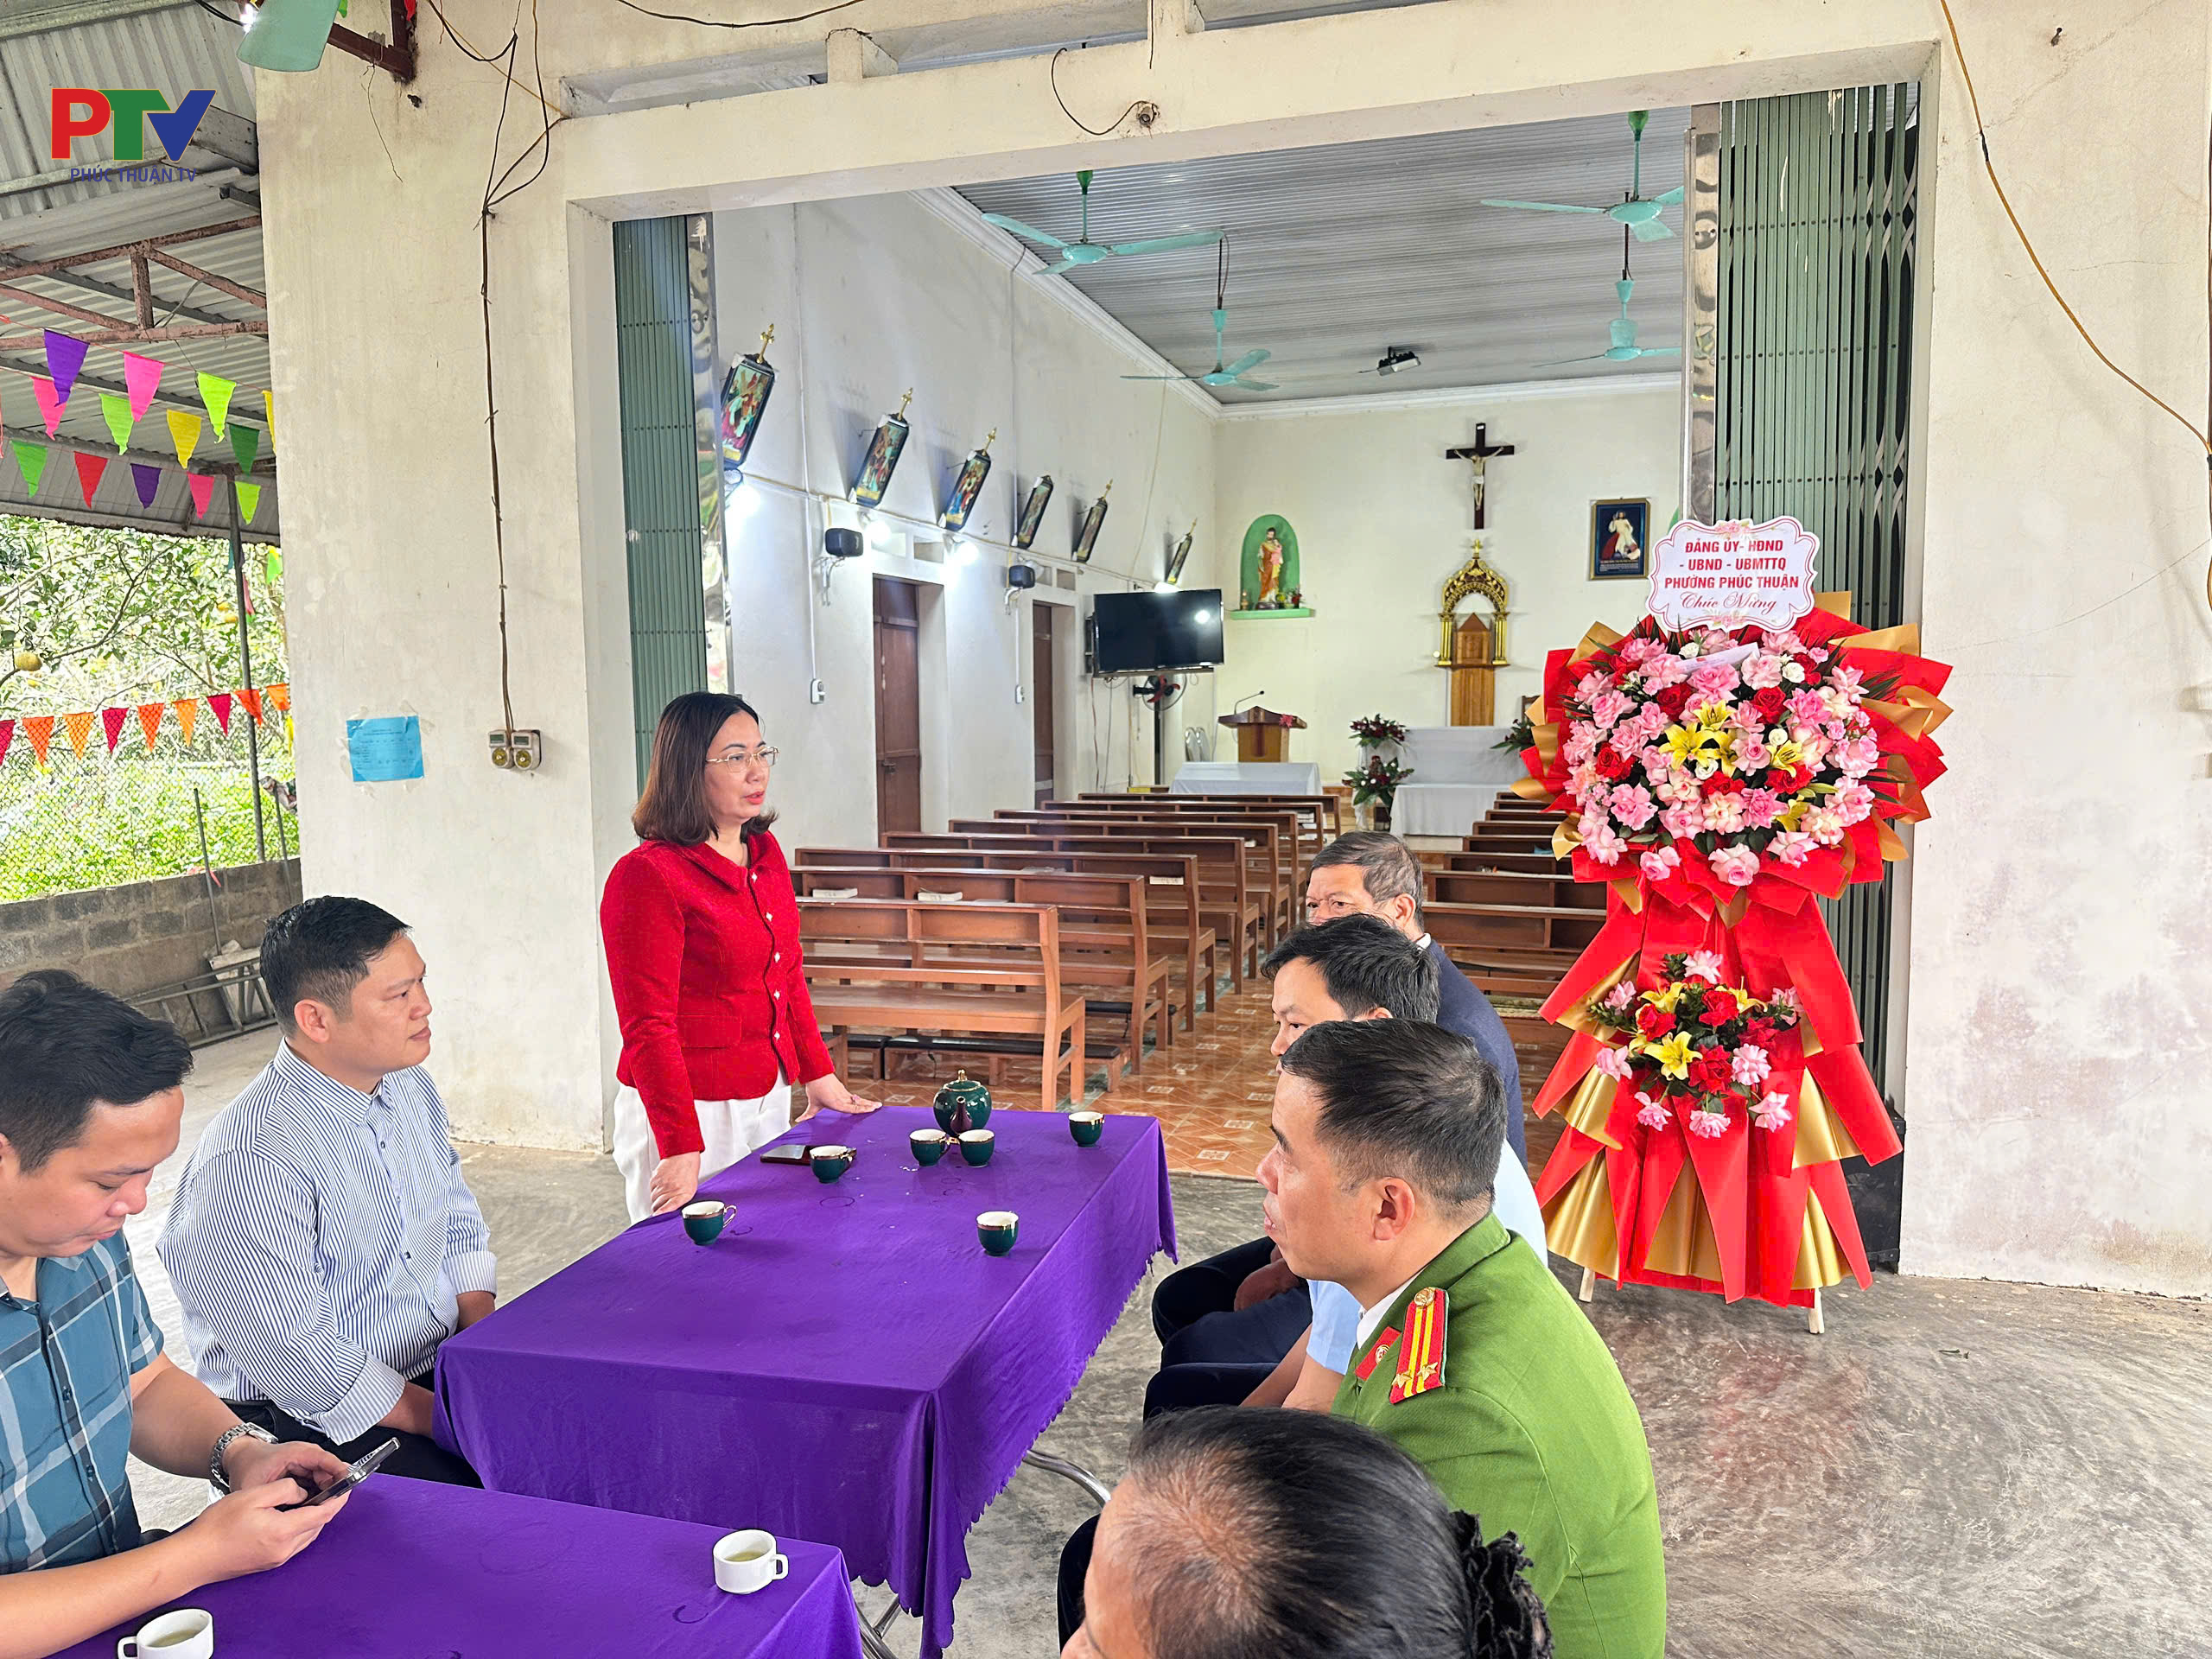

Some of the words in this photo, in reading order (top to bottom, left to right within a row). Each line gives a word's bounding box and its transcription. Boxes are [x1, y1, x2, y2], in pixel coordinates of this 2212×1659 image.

[1685, 537, 1719, 553] ĐẢNG
[1748, 539, 1783, 552] HĐND
[1688, 558, 1722, 570] UBND
[1735, 557, 1786, 571] UBMTTQ
[1664, 574, 1715, 588] PHƯỜNG
[1719, 574, 1752, 588] PHÚC
[1757, 574, 1799, 591] THUẬN
[1680, 591, 1719, 609] Chúc
[1723, 591, 1777, 616] Mừng
